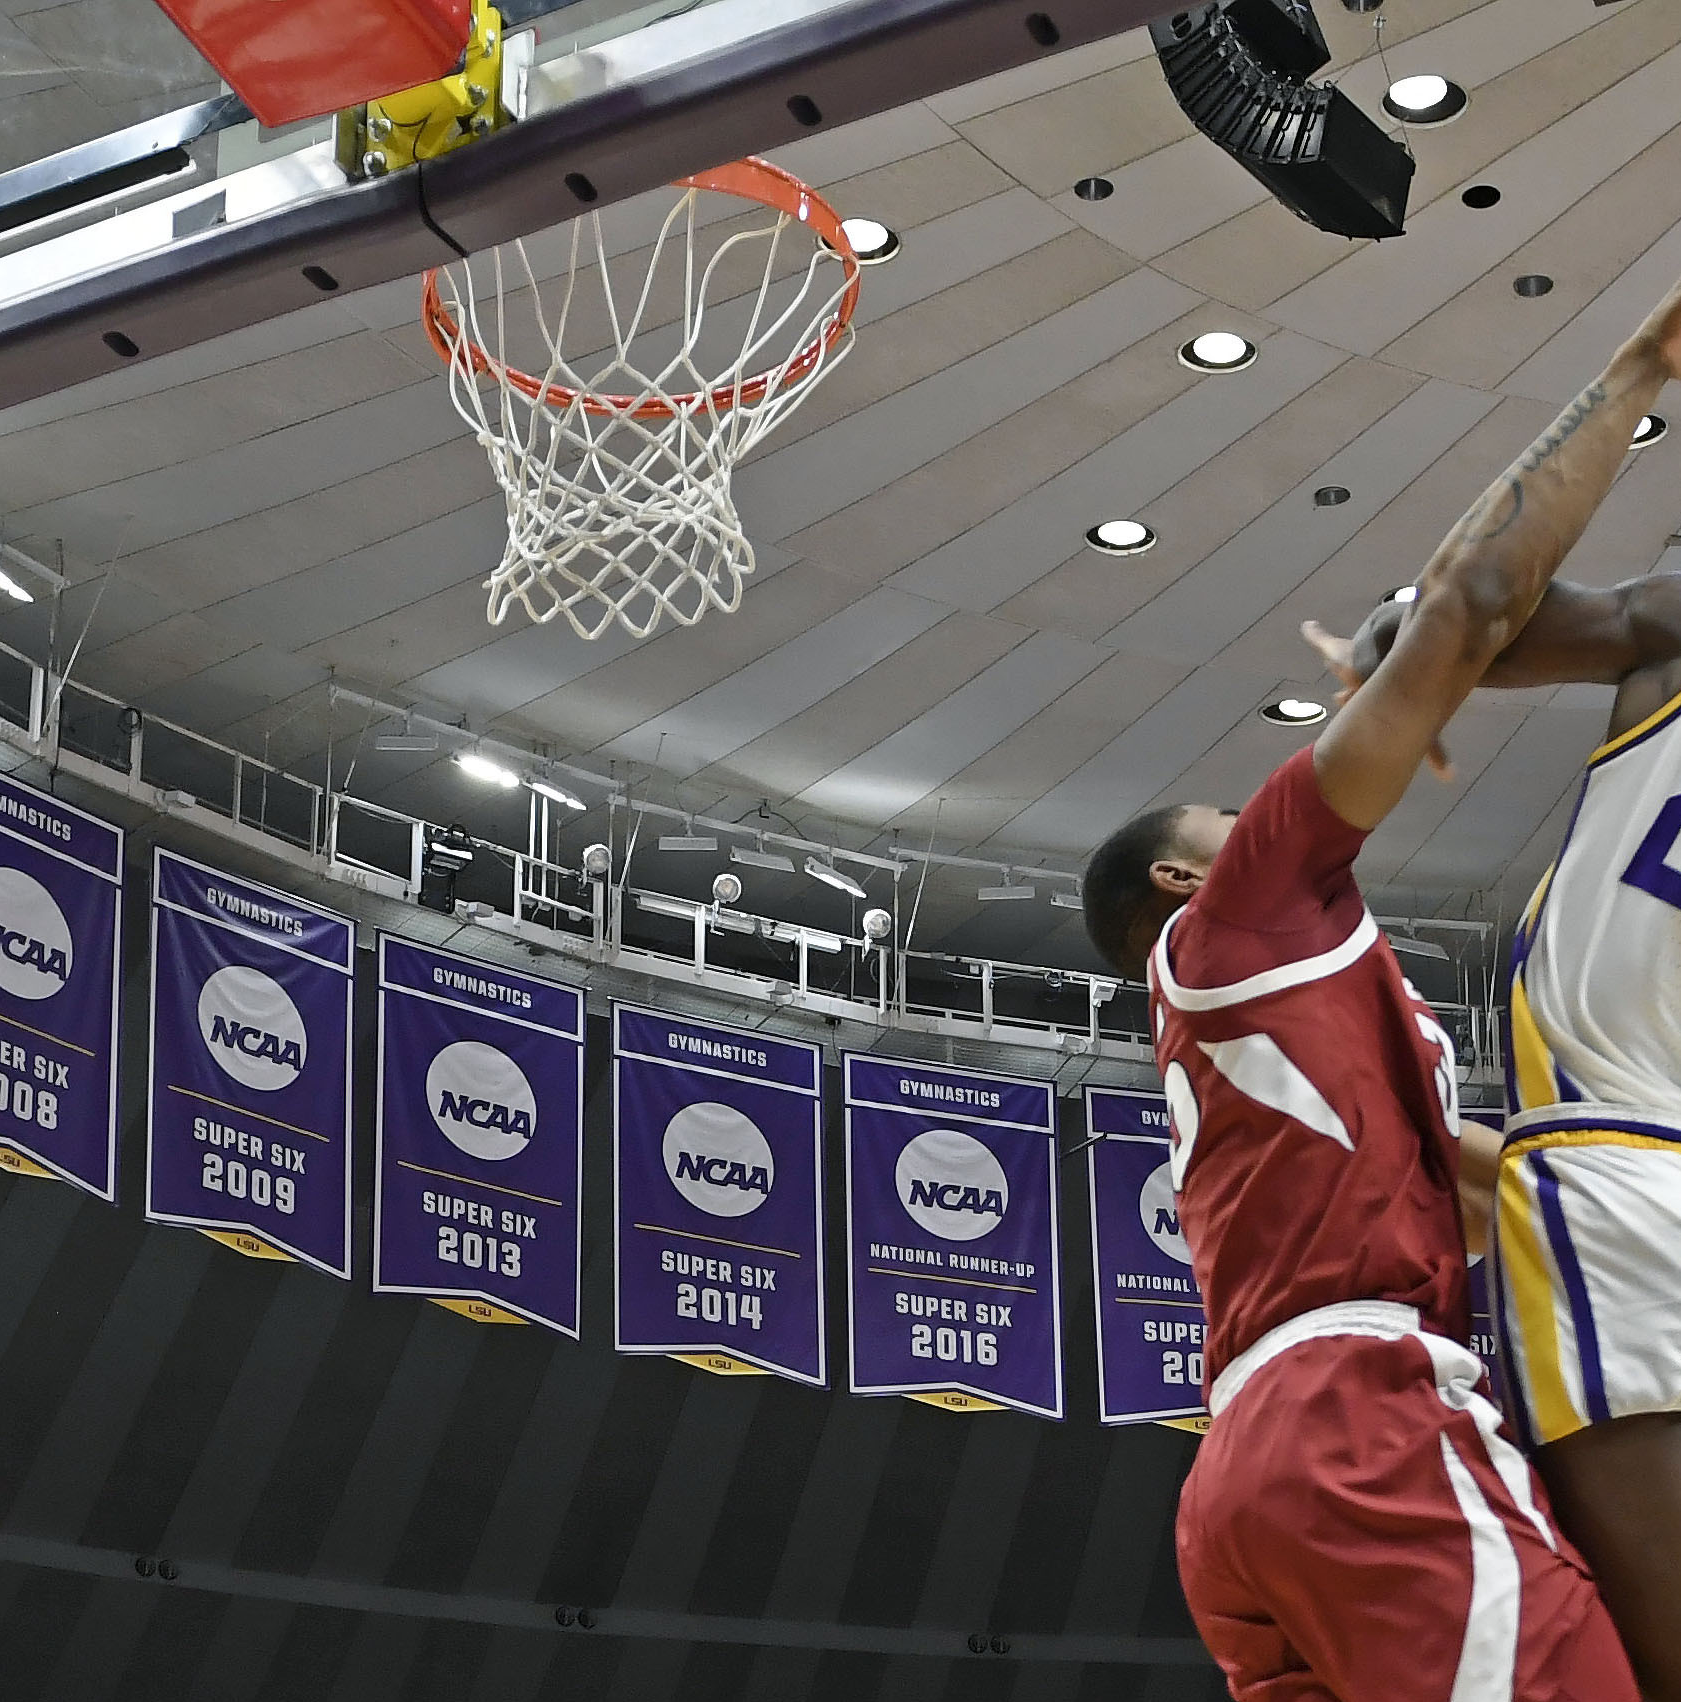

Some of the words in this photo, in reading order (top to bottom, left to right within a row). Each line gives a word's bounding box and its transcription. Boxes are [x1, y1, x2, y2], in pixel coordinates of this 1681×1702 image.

[206, 887, 303, 937] GYMNASTICS
[433, 967, 532, 1010] GYMNASTICS
[209, 1014, 304, 1071] NCAA
[668, 1033, 767, 1068] GYMNASTICS
[33, 1058, 70, 1089] SIX
[899, 1079, 1001, 1108] GYMNASTICS
[438, 1089, 532, 1140] NCAA
[192, 1116, 264, 1163] SUPER
[270, 1142, 307, 1175] SIX
[201, 1151, 296, 1215] 2009
[675, 1151, 771, 1195] NCAA
[423, 1190, 494, 1229] SUPER
[500, 1210, 537, 1239] SIX
[908, 1178, 1005, 1218] NCAA
[437, 1226, 522, 1278] 2013
[661, 1249, 732, 1284] SUPER
[740, 1267, 777, 1291] SIX
[870, 1243, 944, 1267] NATIONAL
[949, 1252, 1036, 1278] RUNNER-UP
[1117, 1273, 1191, 1293] NATIONAL
[676, 1283, 763, 1331] 2014
[895, 1292, 968, 1322] SUPER
[975, 1303, 1014, 1328] SIX
[708, 1358, 732, 1371] LSU
[910, 1323, 999, 1367] 2016
